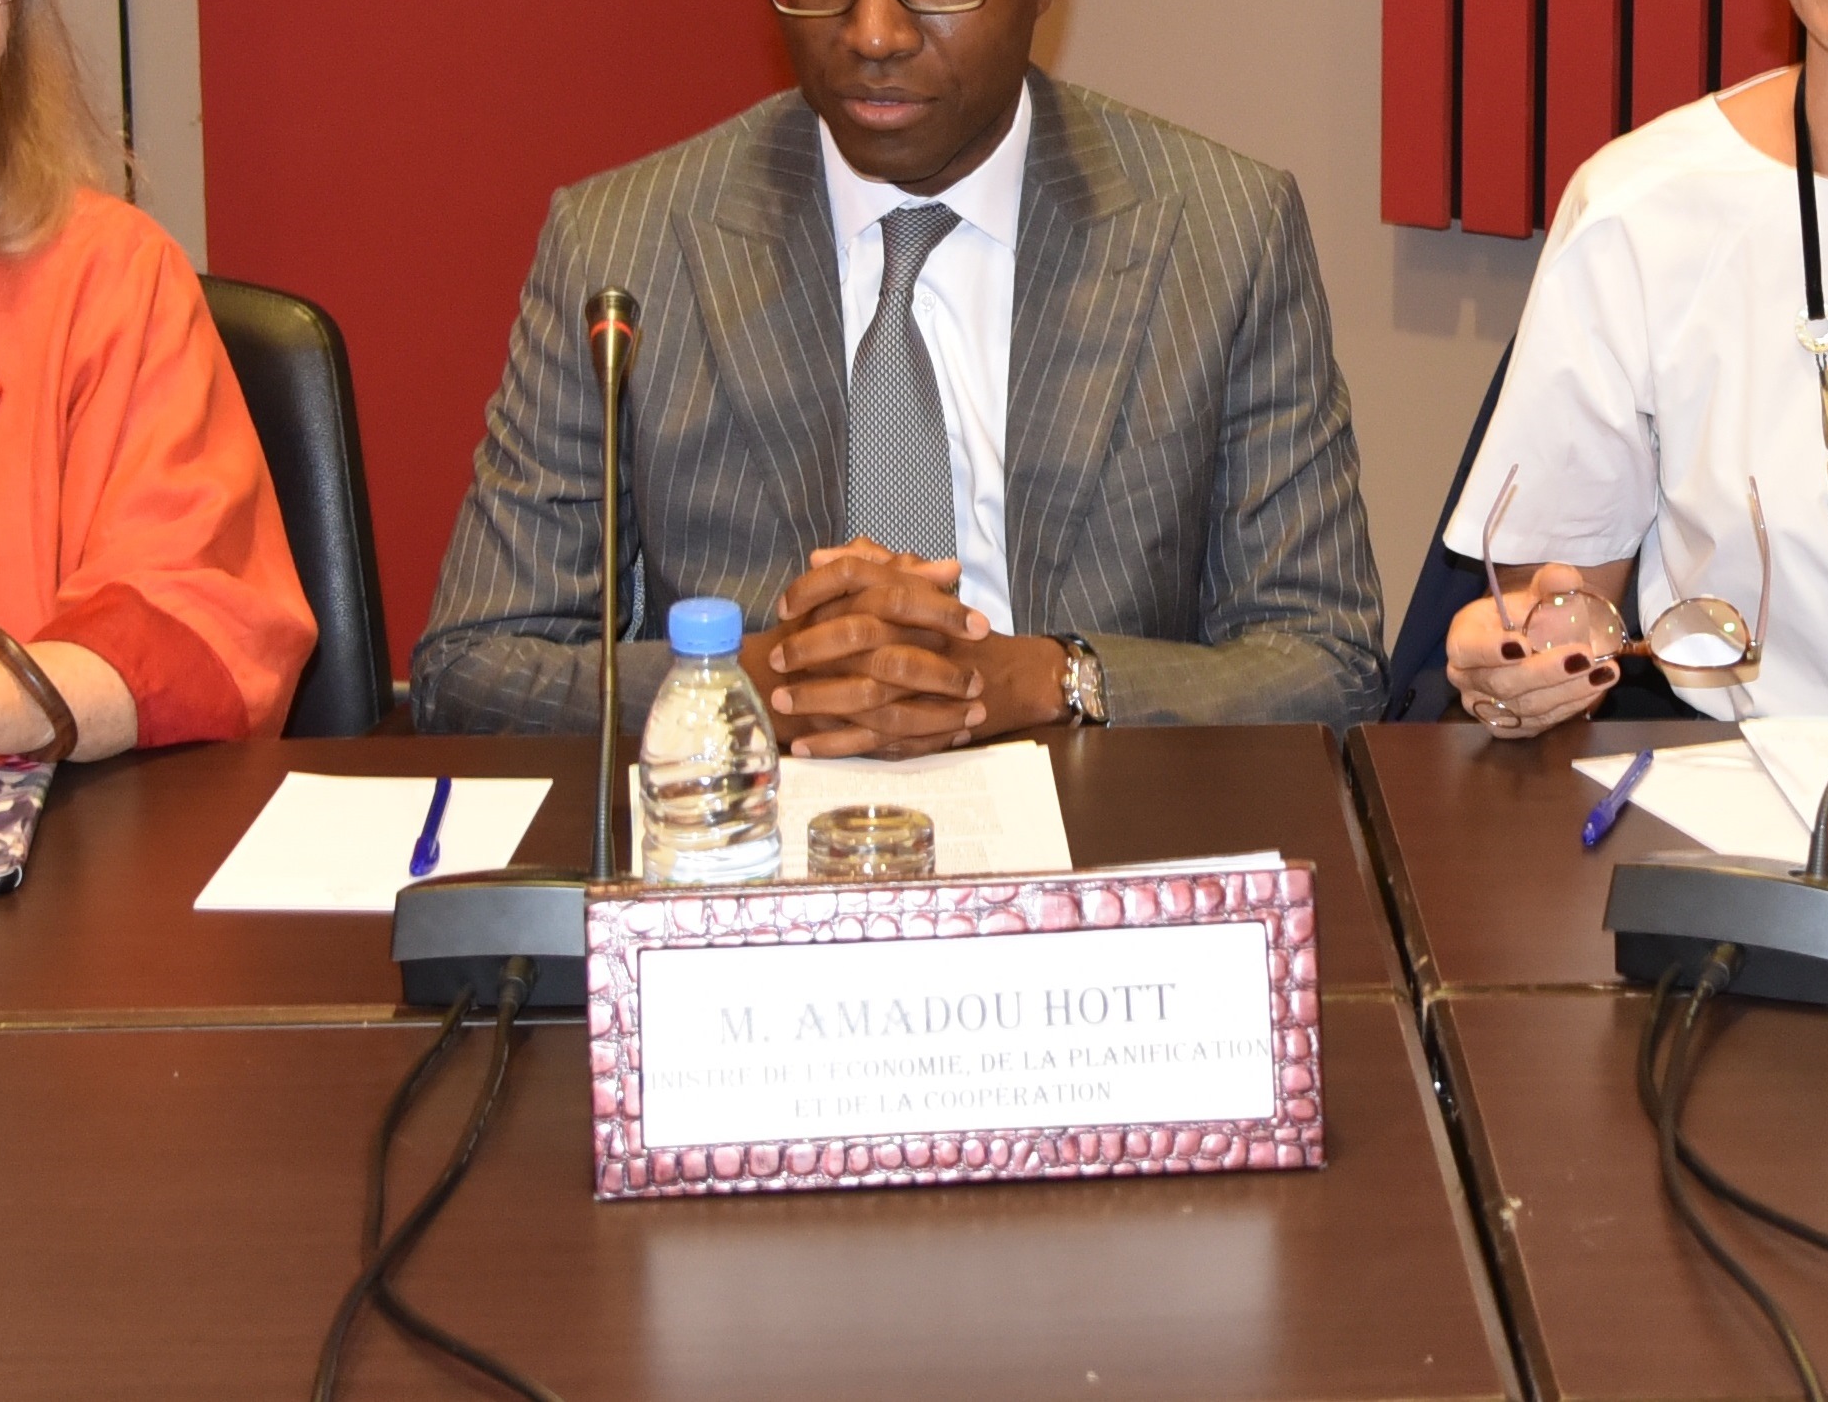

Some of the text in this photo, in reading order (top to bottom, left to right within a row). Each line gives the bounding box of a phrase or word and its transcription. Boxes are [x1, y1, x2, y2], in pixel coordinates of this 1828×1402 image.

[720, 982, 1177, 1045] M. AMADOU HOTT
[648, 1066, 752, 1093] INISTRE
[764, 1064, 796, 1086] DE
[981, 1051, 1014, 1074] DE
[1024, 1049, 1057, 1071] LA
[1069, 1038, 1270, 1068] PLANIFICATION
[794, 1097, 825, 1119] ET
[836, 1094, 870, 1117] DE
[879, 1092, 913, 1114] LA
